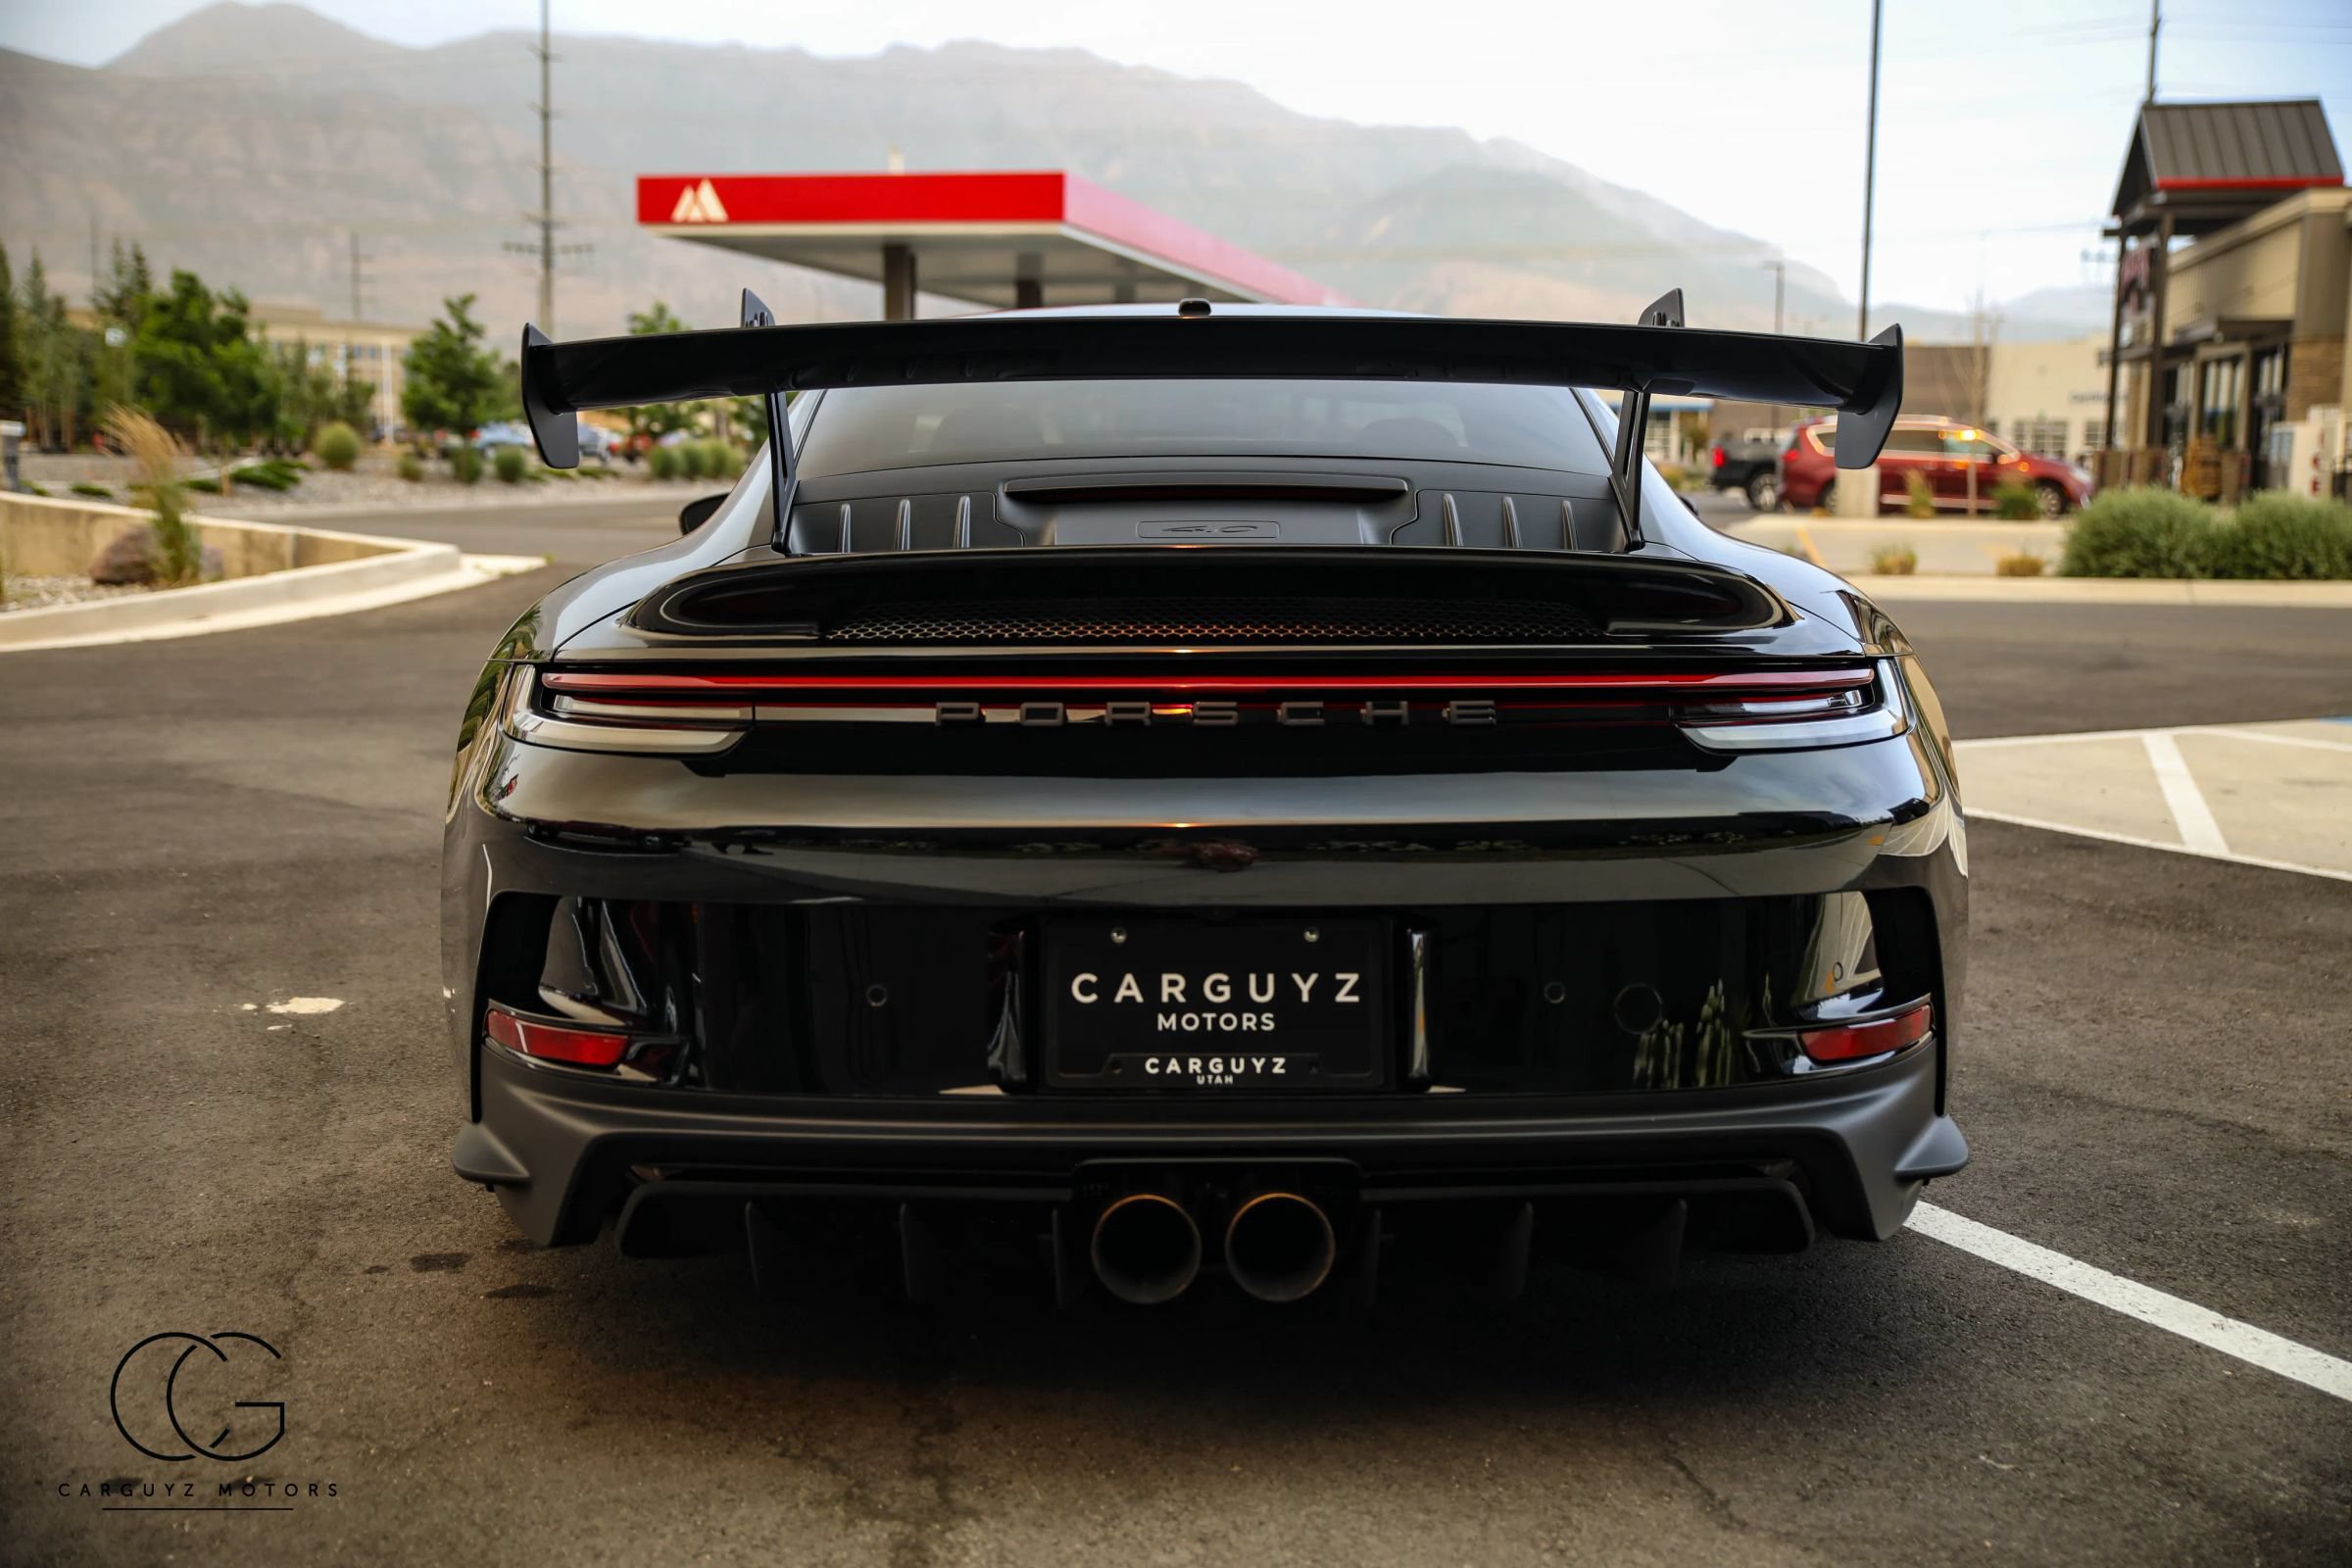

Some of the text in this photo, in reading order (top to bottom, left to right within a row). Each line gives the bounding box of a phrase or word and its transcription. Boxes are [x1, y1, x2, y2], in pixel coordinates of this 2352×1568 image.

[935, 700, 1496, 727] PORSCHE
[1071, 972, 1360, 1004] CARGUYZ
[1157, 1012, 1276, 1032] MOTORS
[1145, 1057, 1287, 1074] CARGUYZ
[1197, 1074, 1234, 1085] UTAH
